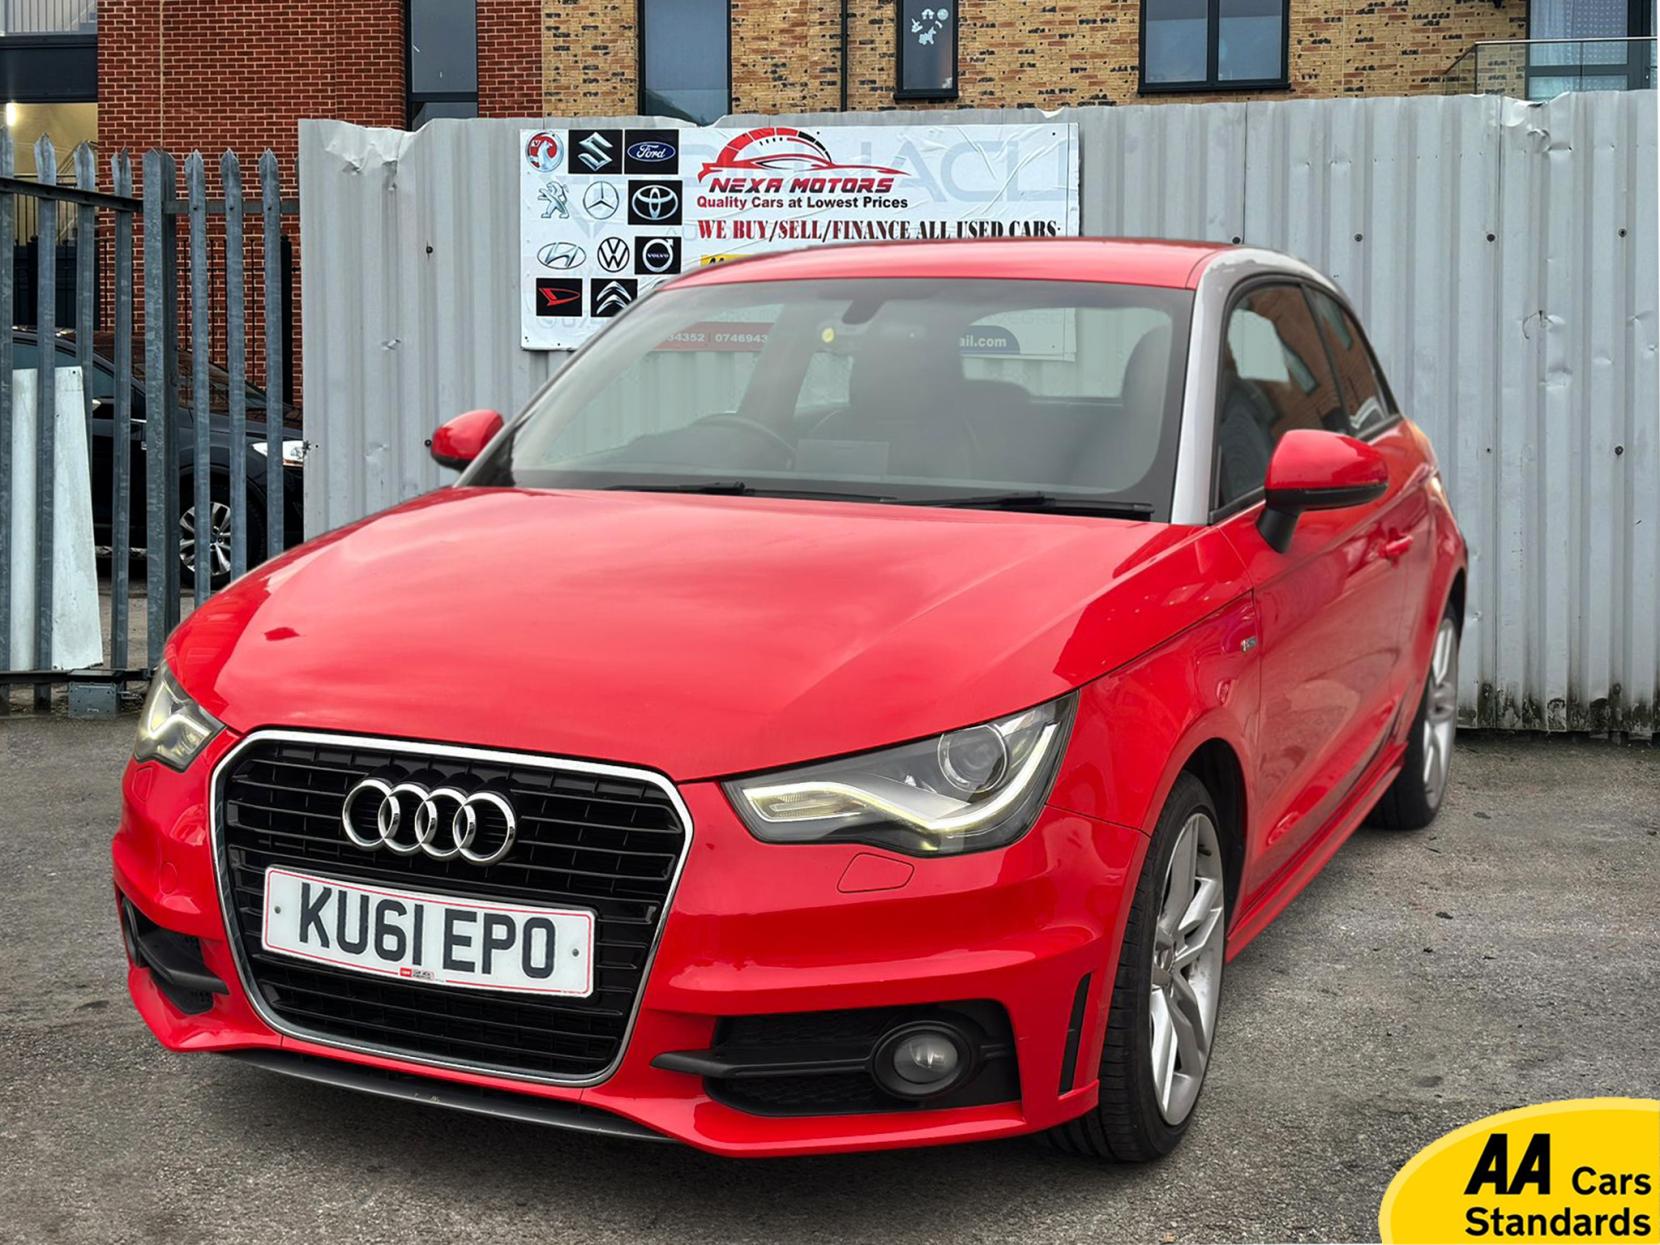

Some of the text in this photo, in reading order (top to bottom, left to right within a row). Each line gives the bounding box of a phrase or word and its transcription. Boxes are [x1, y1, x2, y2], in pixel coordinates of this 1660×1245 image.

[636, 145, 666, 159] Ford
[708, 178, 894, 193] NEXA MOTORS
[697, 196, 908, 210] Quality Cars at Lowest Prices
[697, 220, 726, 239] WE
[733, 220, 911, 242] BUY/SELL/FINANCE
[916, 220, 950, 239] ALL
[956, 220, 1004, 238] USED
[1008, 220, 1057, 238] CARS
[299, 882, 556, 979] KU61 EPO
